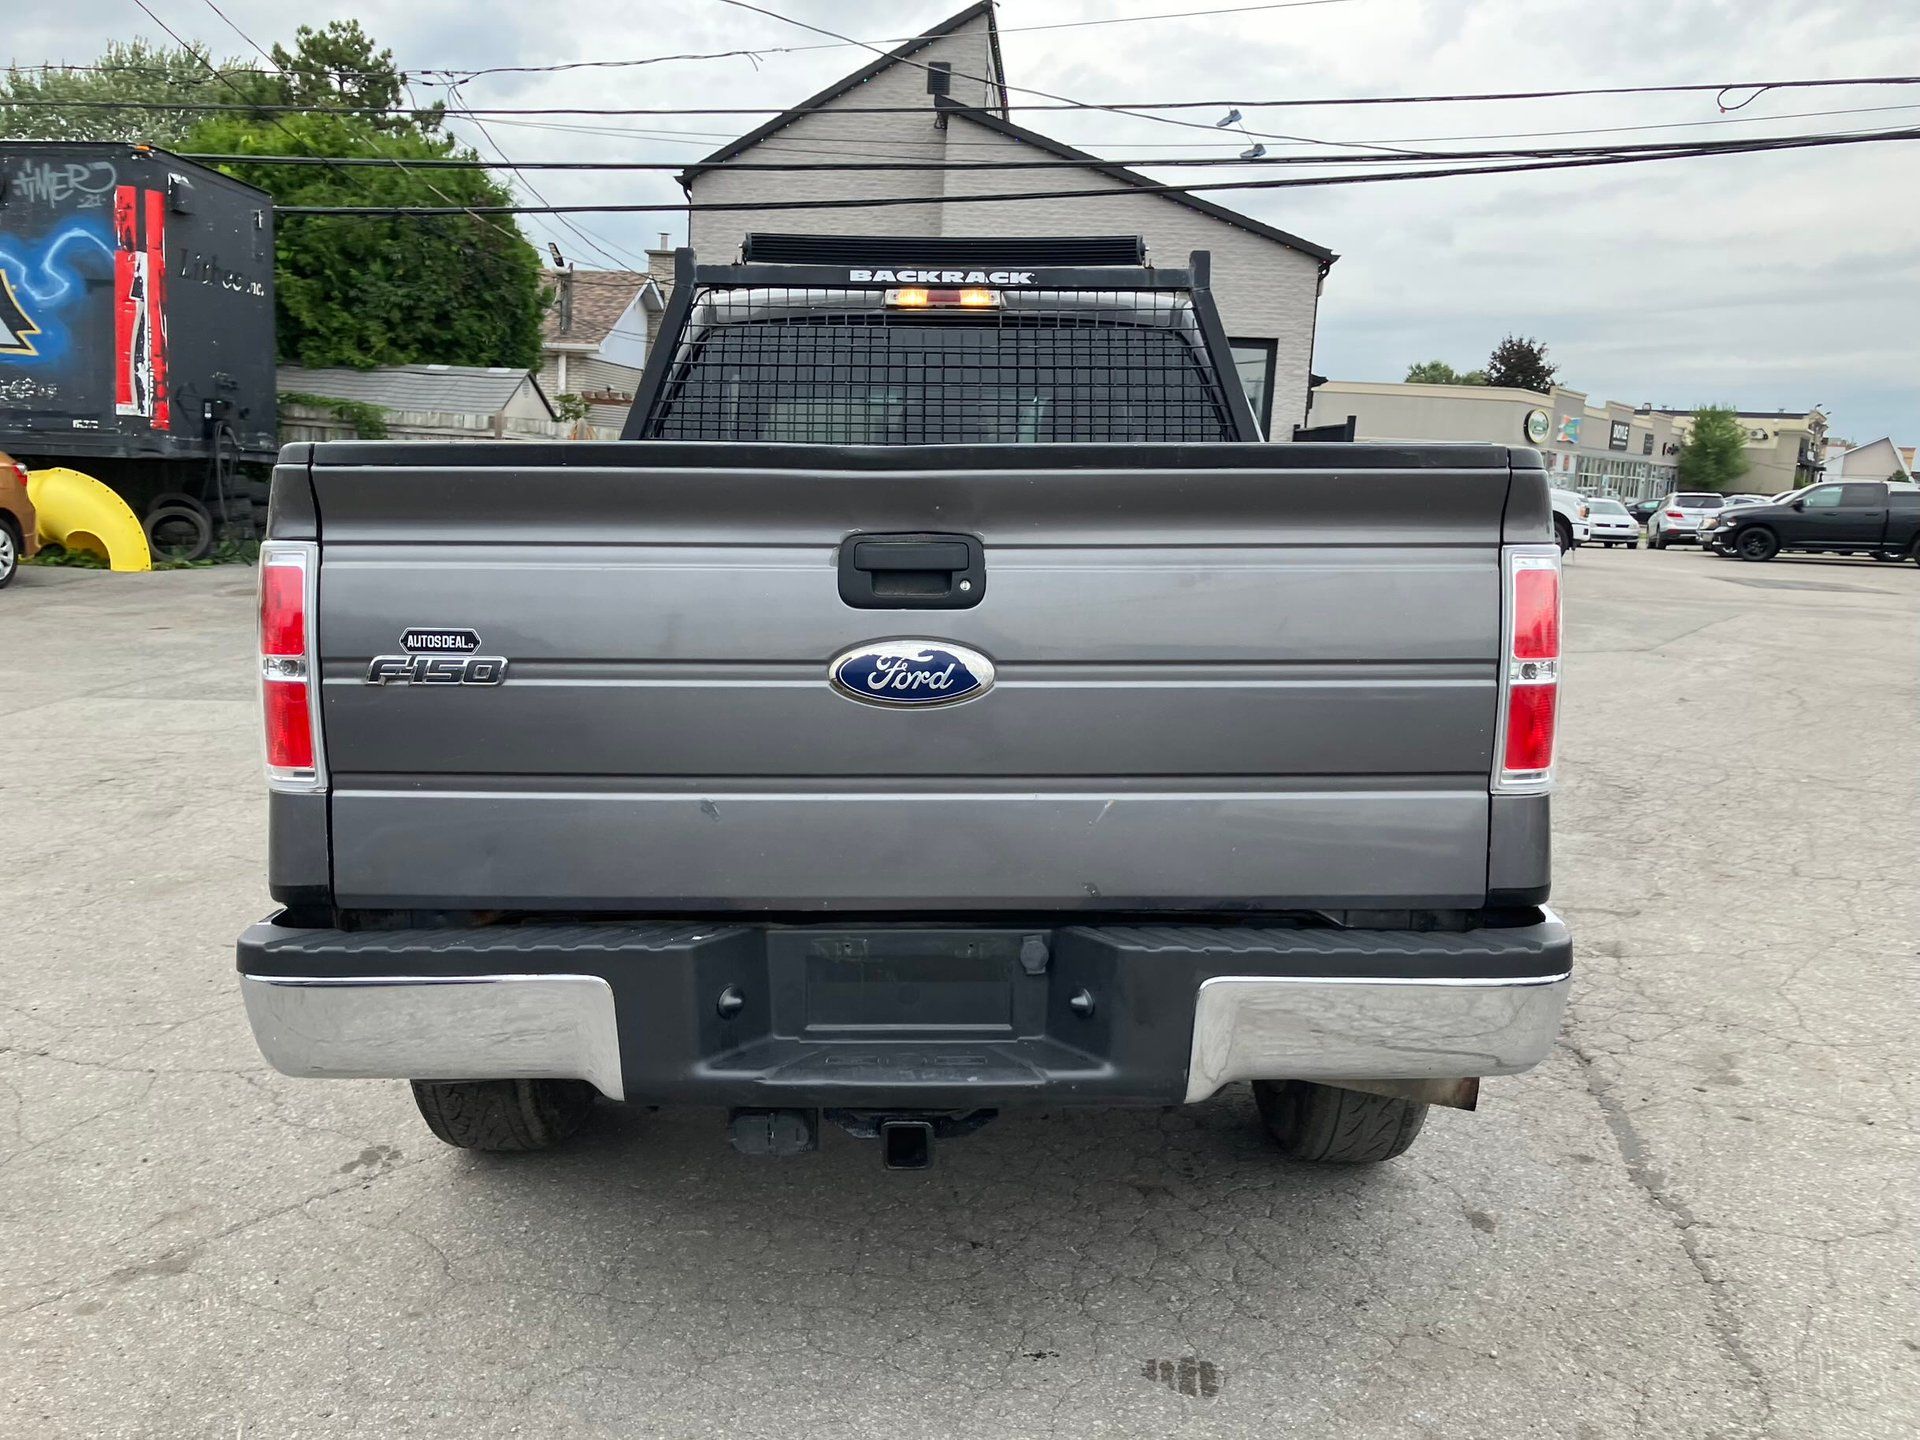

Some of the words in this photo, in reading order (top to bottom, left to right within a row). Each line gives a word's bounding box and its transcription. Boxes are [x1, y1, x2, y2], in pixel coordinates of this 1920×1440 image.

[849, 269, 1033, 285] BACKRACK
[366, 655, 509, 687] F-150
[867, 651, 957, 691] Ford
